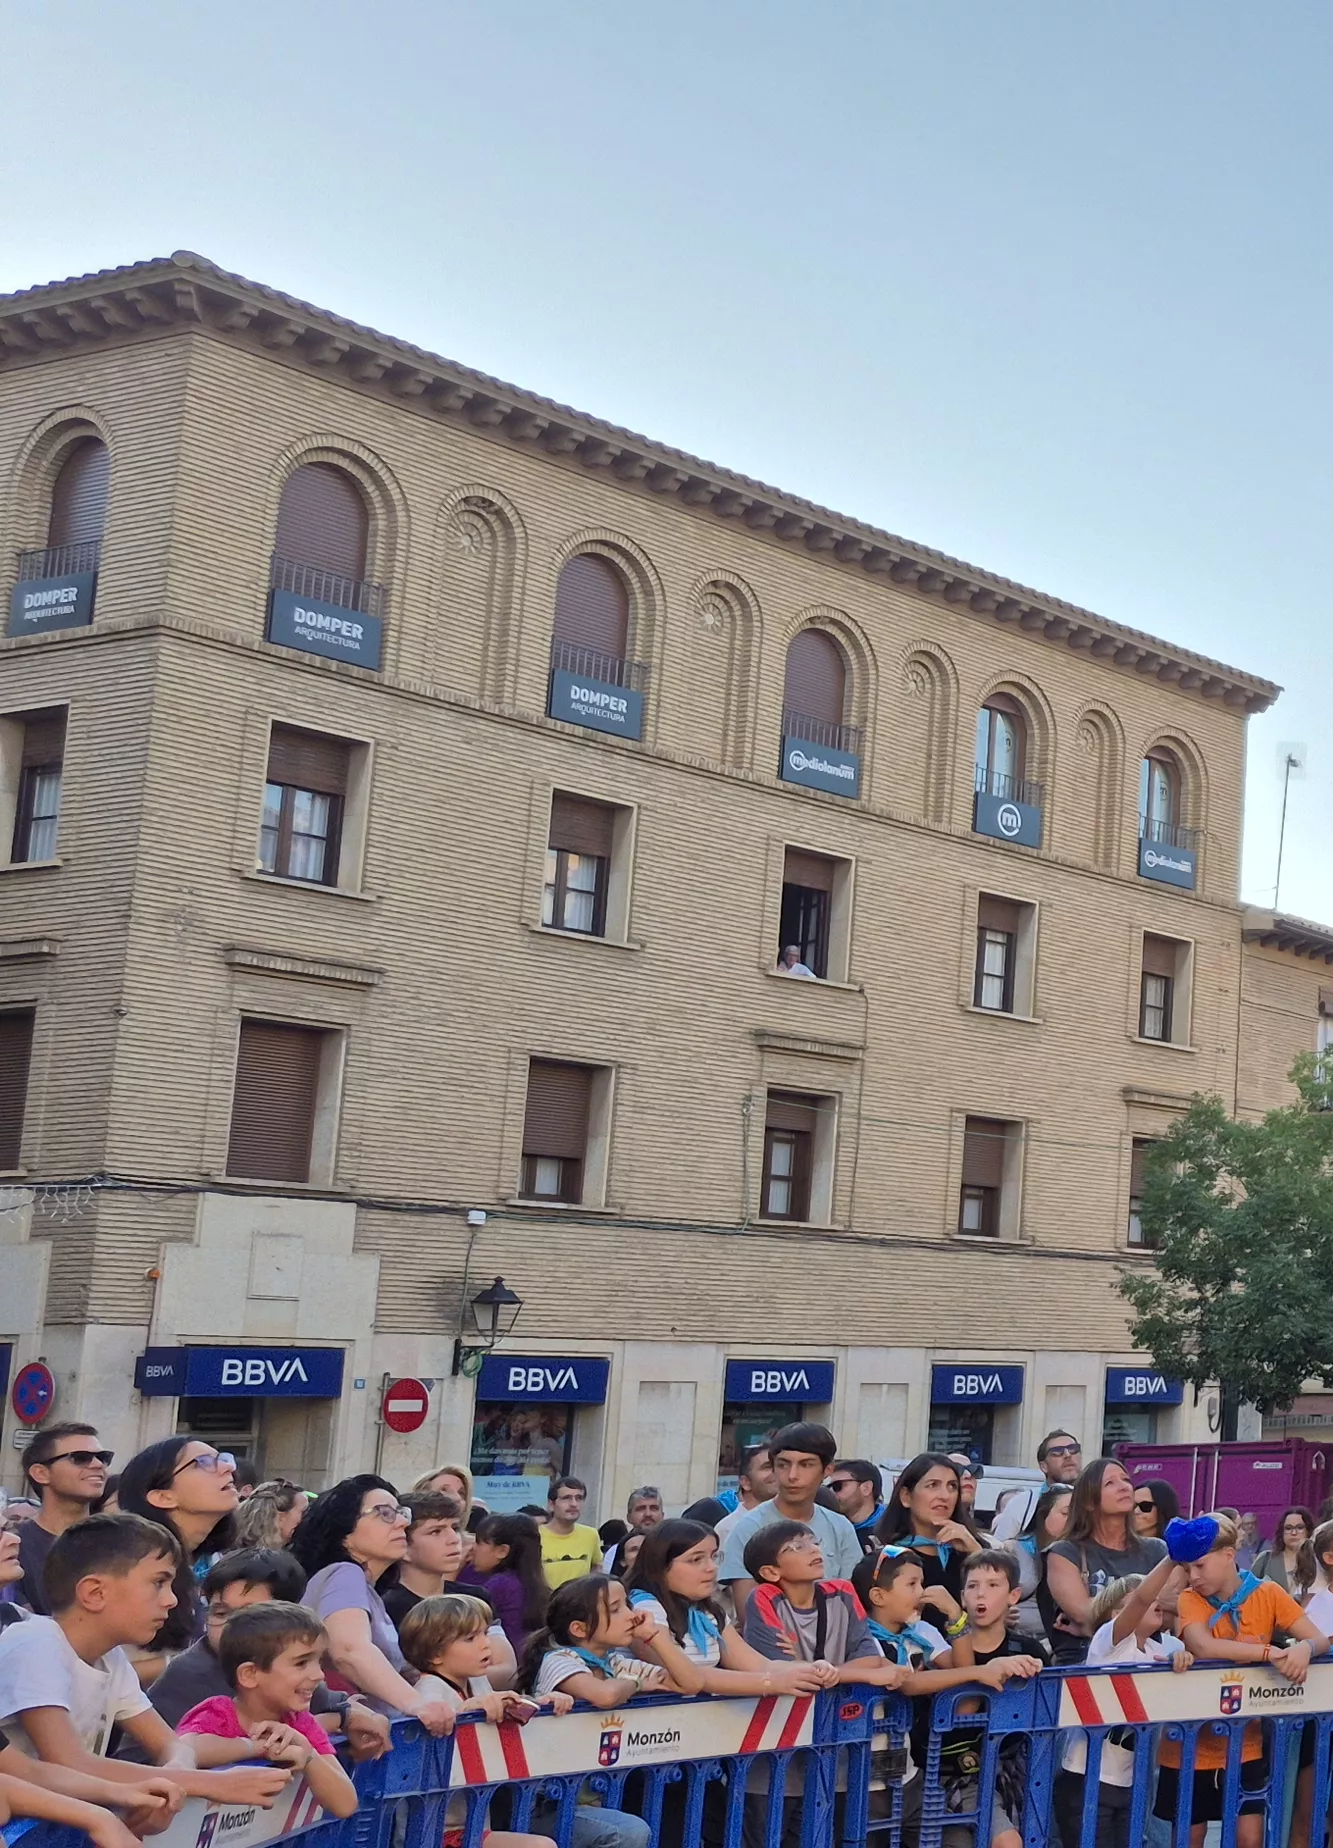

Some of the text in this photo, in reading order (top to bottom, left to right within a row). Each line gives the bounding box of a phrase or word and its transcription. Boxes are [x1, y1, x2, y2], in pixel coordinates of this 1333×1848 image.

[24, 587, 78, 609] DOMPER
[293, 607, 364, 640] DOMPER
[294, 626, 361, 650] ARQUITECTURA
[570, 685, 628, 713] DOMPER
[570, 702, 626, 723] ARQUITECTURA
[146, 1365, 174, 1378] BBVA
[221, 1357, 309, 1385] BBVA
[508, 1366, 579, 1392] BBVA
[751, 1369, 810, 1393] BBVA
[953, 1373, 1003, 1395] BBVA
[1124, 1376, 1167, 1395] BBVA
[1249, 1684, 1304, 1699] Monzón
[842, 1704, 860, 1717] JSP
[627, 1727, 681, 1747] Monzón
[626, 1744, 680, 1758] Ayuntamiento
[218, 1805, 256, 1833] Monzón
